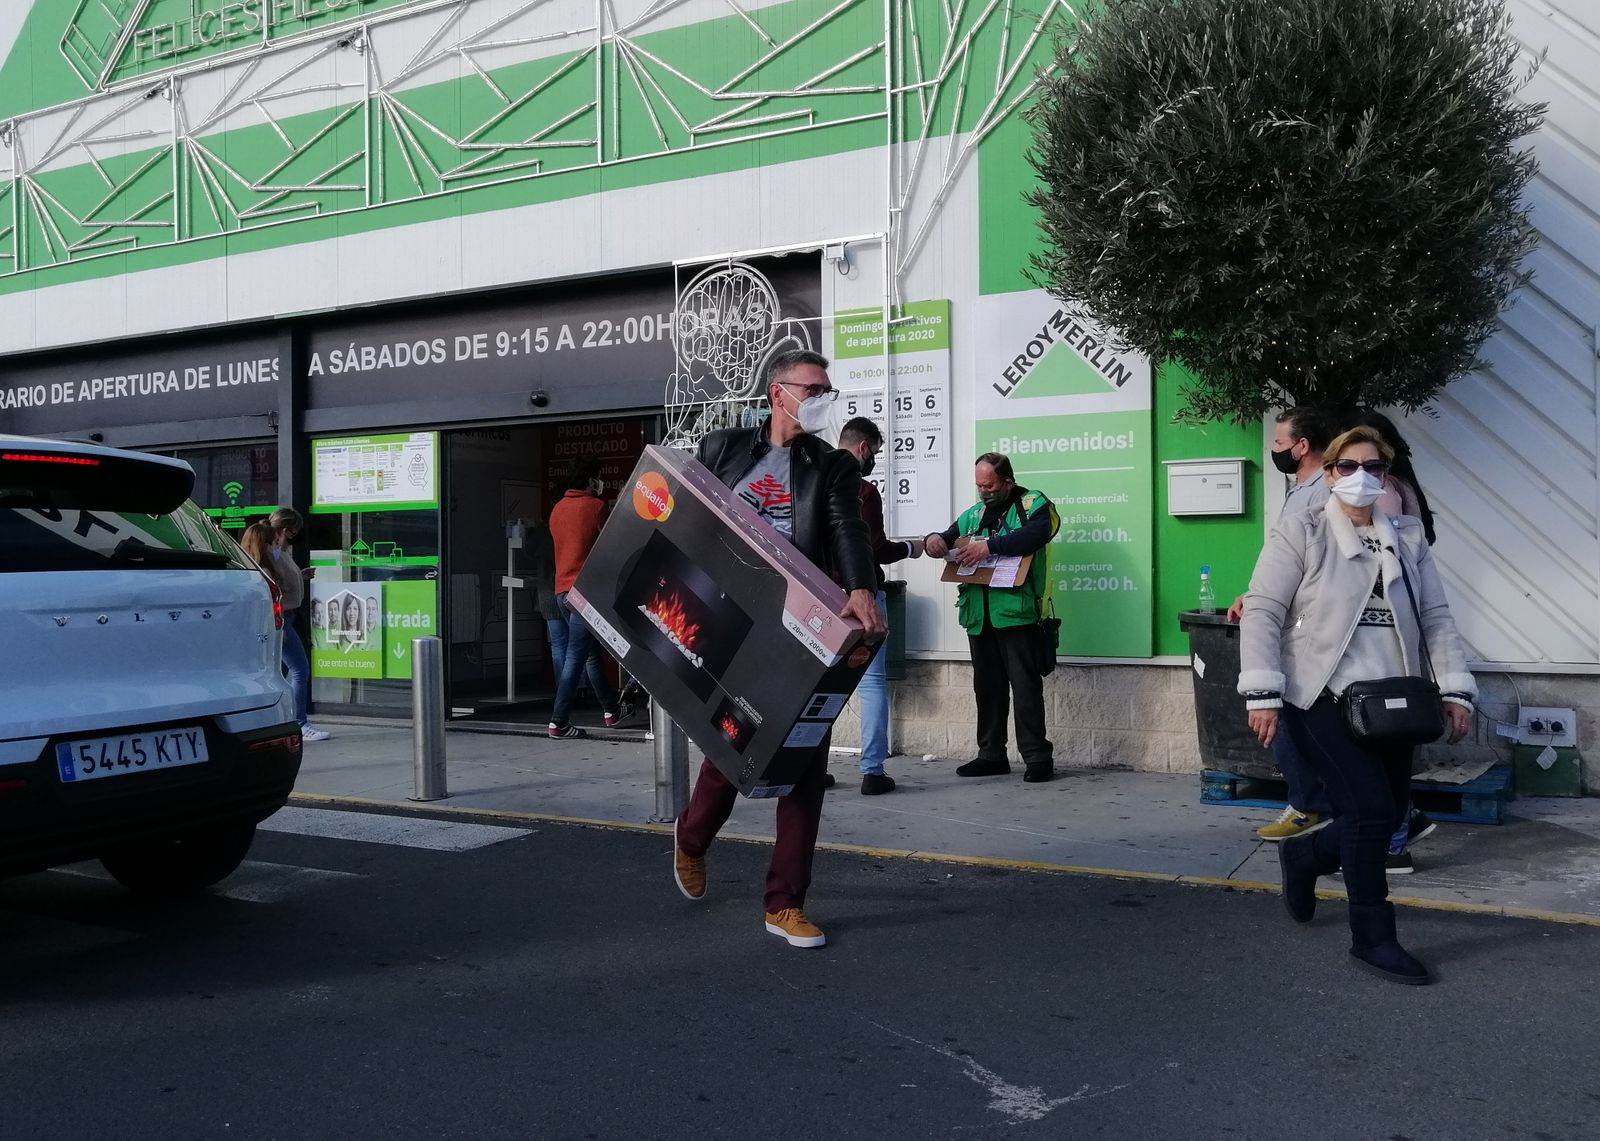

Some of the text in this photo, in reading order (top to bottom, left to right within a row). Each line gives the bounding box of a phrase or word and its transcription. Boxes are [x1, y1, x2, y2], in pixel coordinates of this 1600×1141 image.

[134, 2, 260, 61] FELICES
[840, 321, 886, 334] Domingo
[846, 329, 935, 348] de aperura 2020
[307, 352, 325, 377] A
[328, 338, 447, 374] SÁBADOS
[454, 333, 488, 361] DE
[495, 326, 549, 357] 9:15
[555, 324, 576, 351] A
[992, 309, 1133, 397] LEROY MERLIN
[849, 370, 861, 379] De
[897, 365, 924, 375] 22:00
[926, 363, 933, 372] h
[51, 381, 74, 404] DE
[78, 370, 180, 401] APERTURA
[184, 366, 210, 390] DE
[847, 394, 936, 415] 5 5 15 6
[558, 422, 625, 438] PRODUCTO
[554, 439, 629, 456] DESTACADO
[894, 435, 936, 452] 29 7
[992, 430, 1134, 455] ¡Bienvenidos!
[898, 478, 910, 495] 8
[1076, 493, 1129, 503] comercial:
[1063, 514, 1106, 524] a sábado
[1067, 529, 1113, 543] 22:00
[1117, 527, 1132, 542] h.
[1055, 562, 1113, 573] de apertura
[1058, 576, 1138, 592] a 22:00 h.
[387, 609, 431, 629] trada
[80, 738, 147, 774] 5445
[155, 731, 197, 763] KTY
